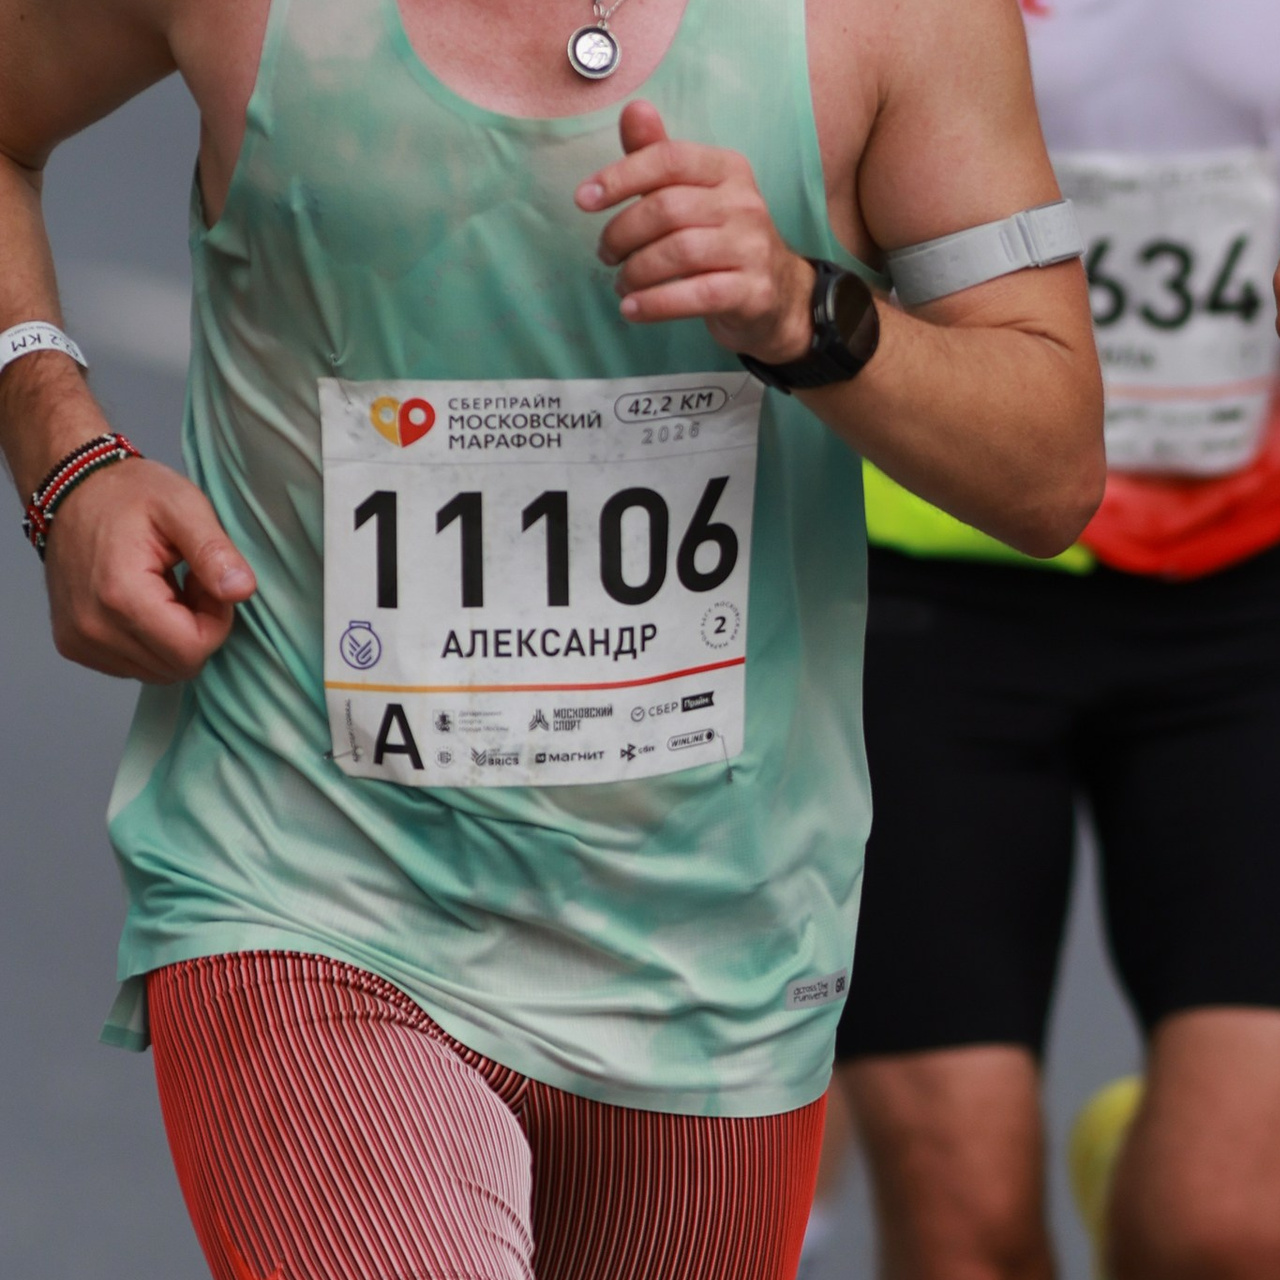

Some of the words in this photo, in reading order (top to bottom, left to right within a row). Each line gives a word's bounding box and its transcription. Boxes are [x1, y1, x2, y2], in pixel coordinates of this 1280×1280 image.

[448, 394, 561, 410] СБЕРПРАЙМ
[628, 396, 672, 417] 42,2
[449, 410, 602, 430] МОСКОВСКИЙ
[449, 432, 562, 450] МАРАФОН
[354, 475, 739, 608] 11106
[714, 615, 726, 634] 2
[441, 623, 657, 661] АЛЕКСАНДР
[553, 704, 614, 720] МОСКОВСКИЙ
[648, 702, 679, 718] СБЕР
[553, 720, 582, 732] СПОРТ
[549, 750, 605, 763] магнит
